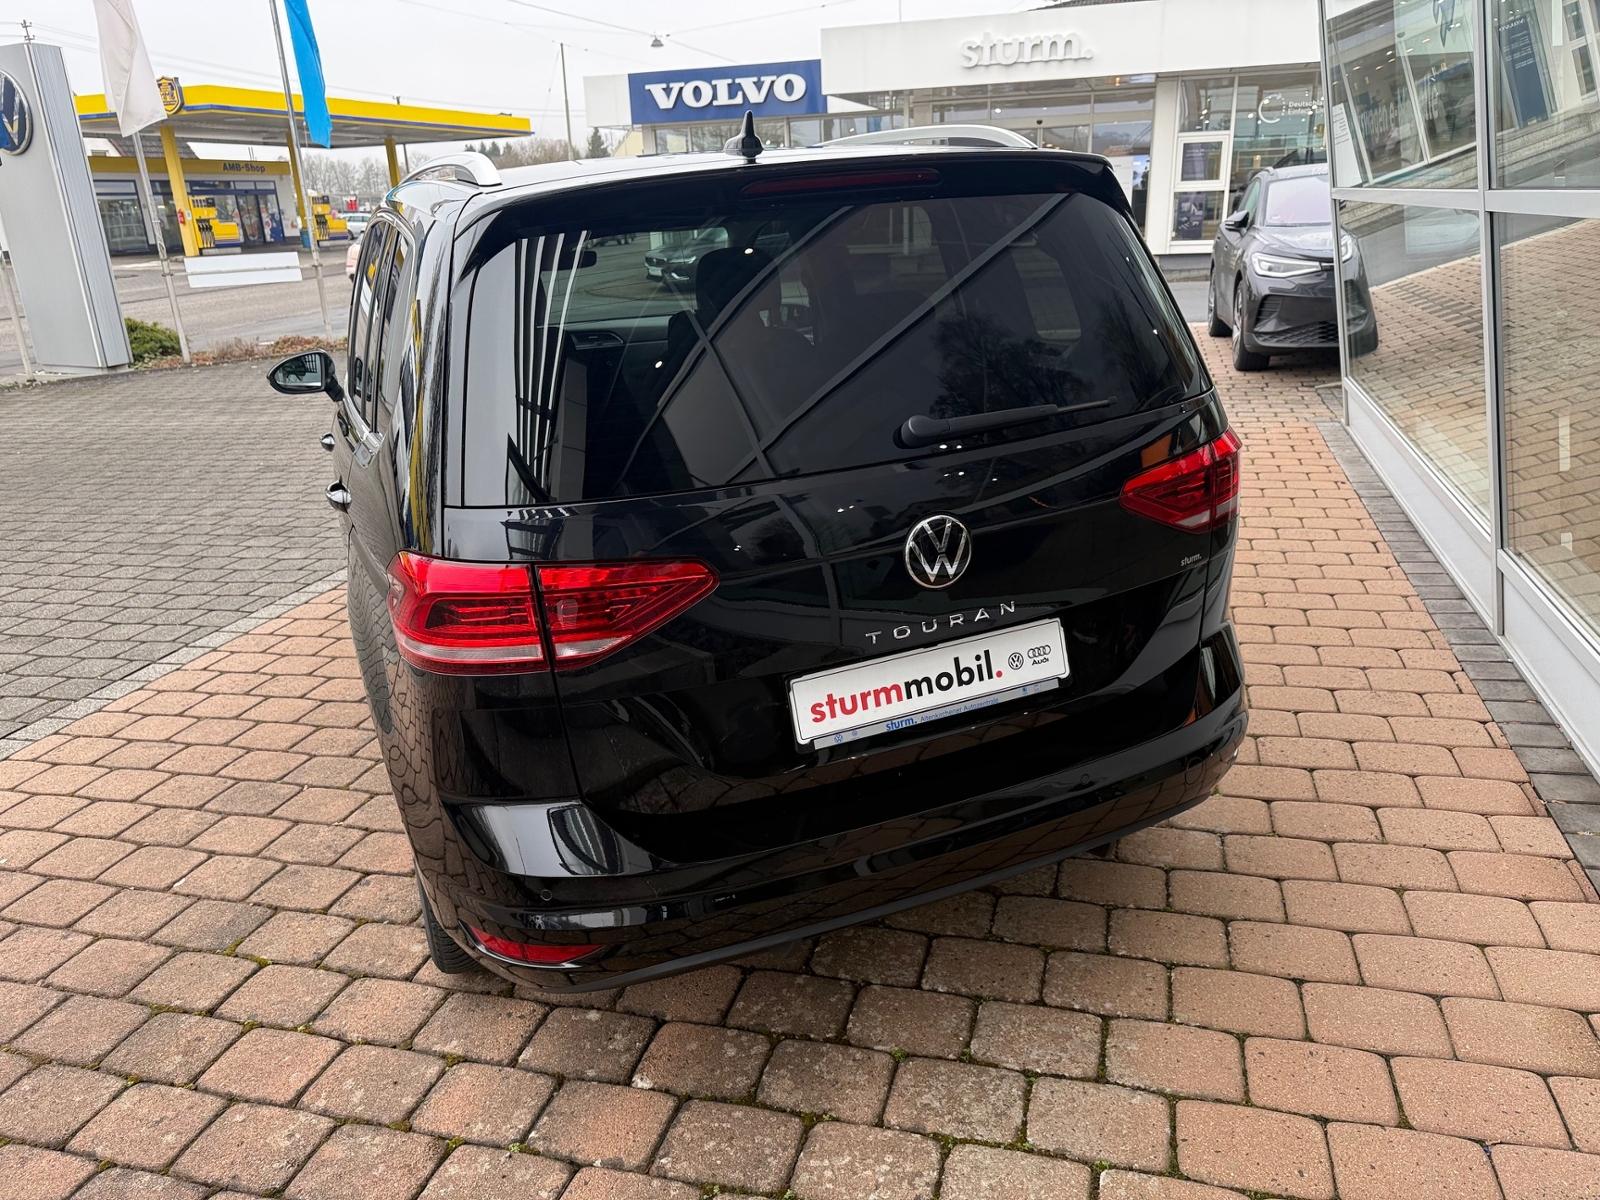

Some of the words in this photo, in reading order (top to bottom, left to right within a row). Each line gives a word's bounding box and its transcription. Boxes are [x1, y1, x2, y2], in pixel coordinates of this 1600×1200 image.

[961, 32, 1094, 69] sturm.
[645, 73, 807, 110] VOLVO
[223, 162, 266, 174] AMB-Shop
[1180, 553, 1202, 567] sturm.
[865, 601, 1015, 645] TOURAN
[1031, 657, 1049, 666] Audi
[885, 717, 918, 732] sturm.
